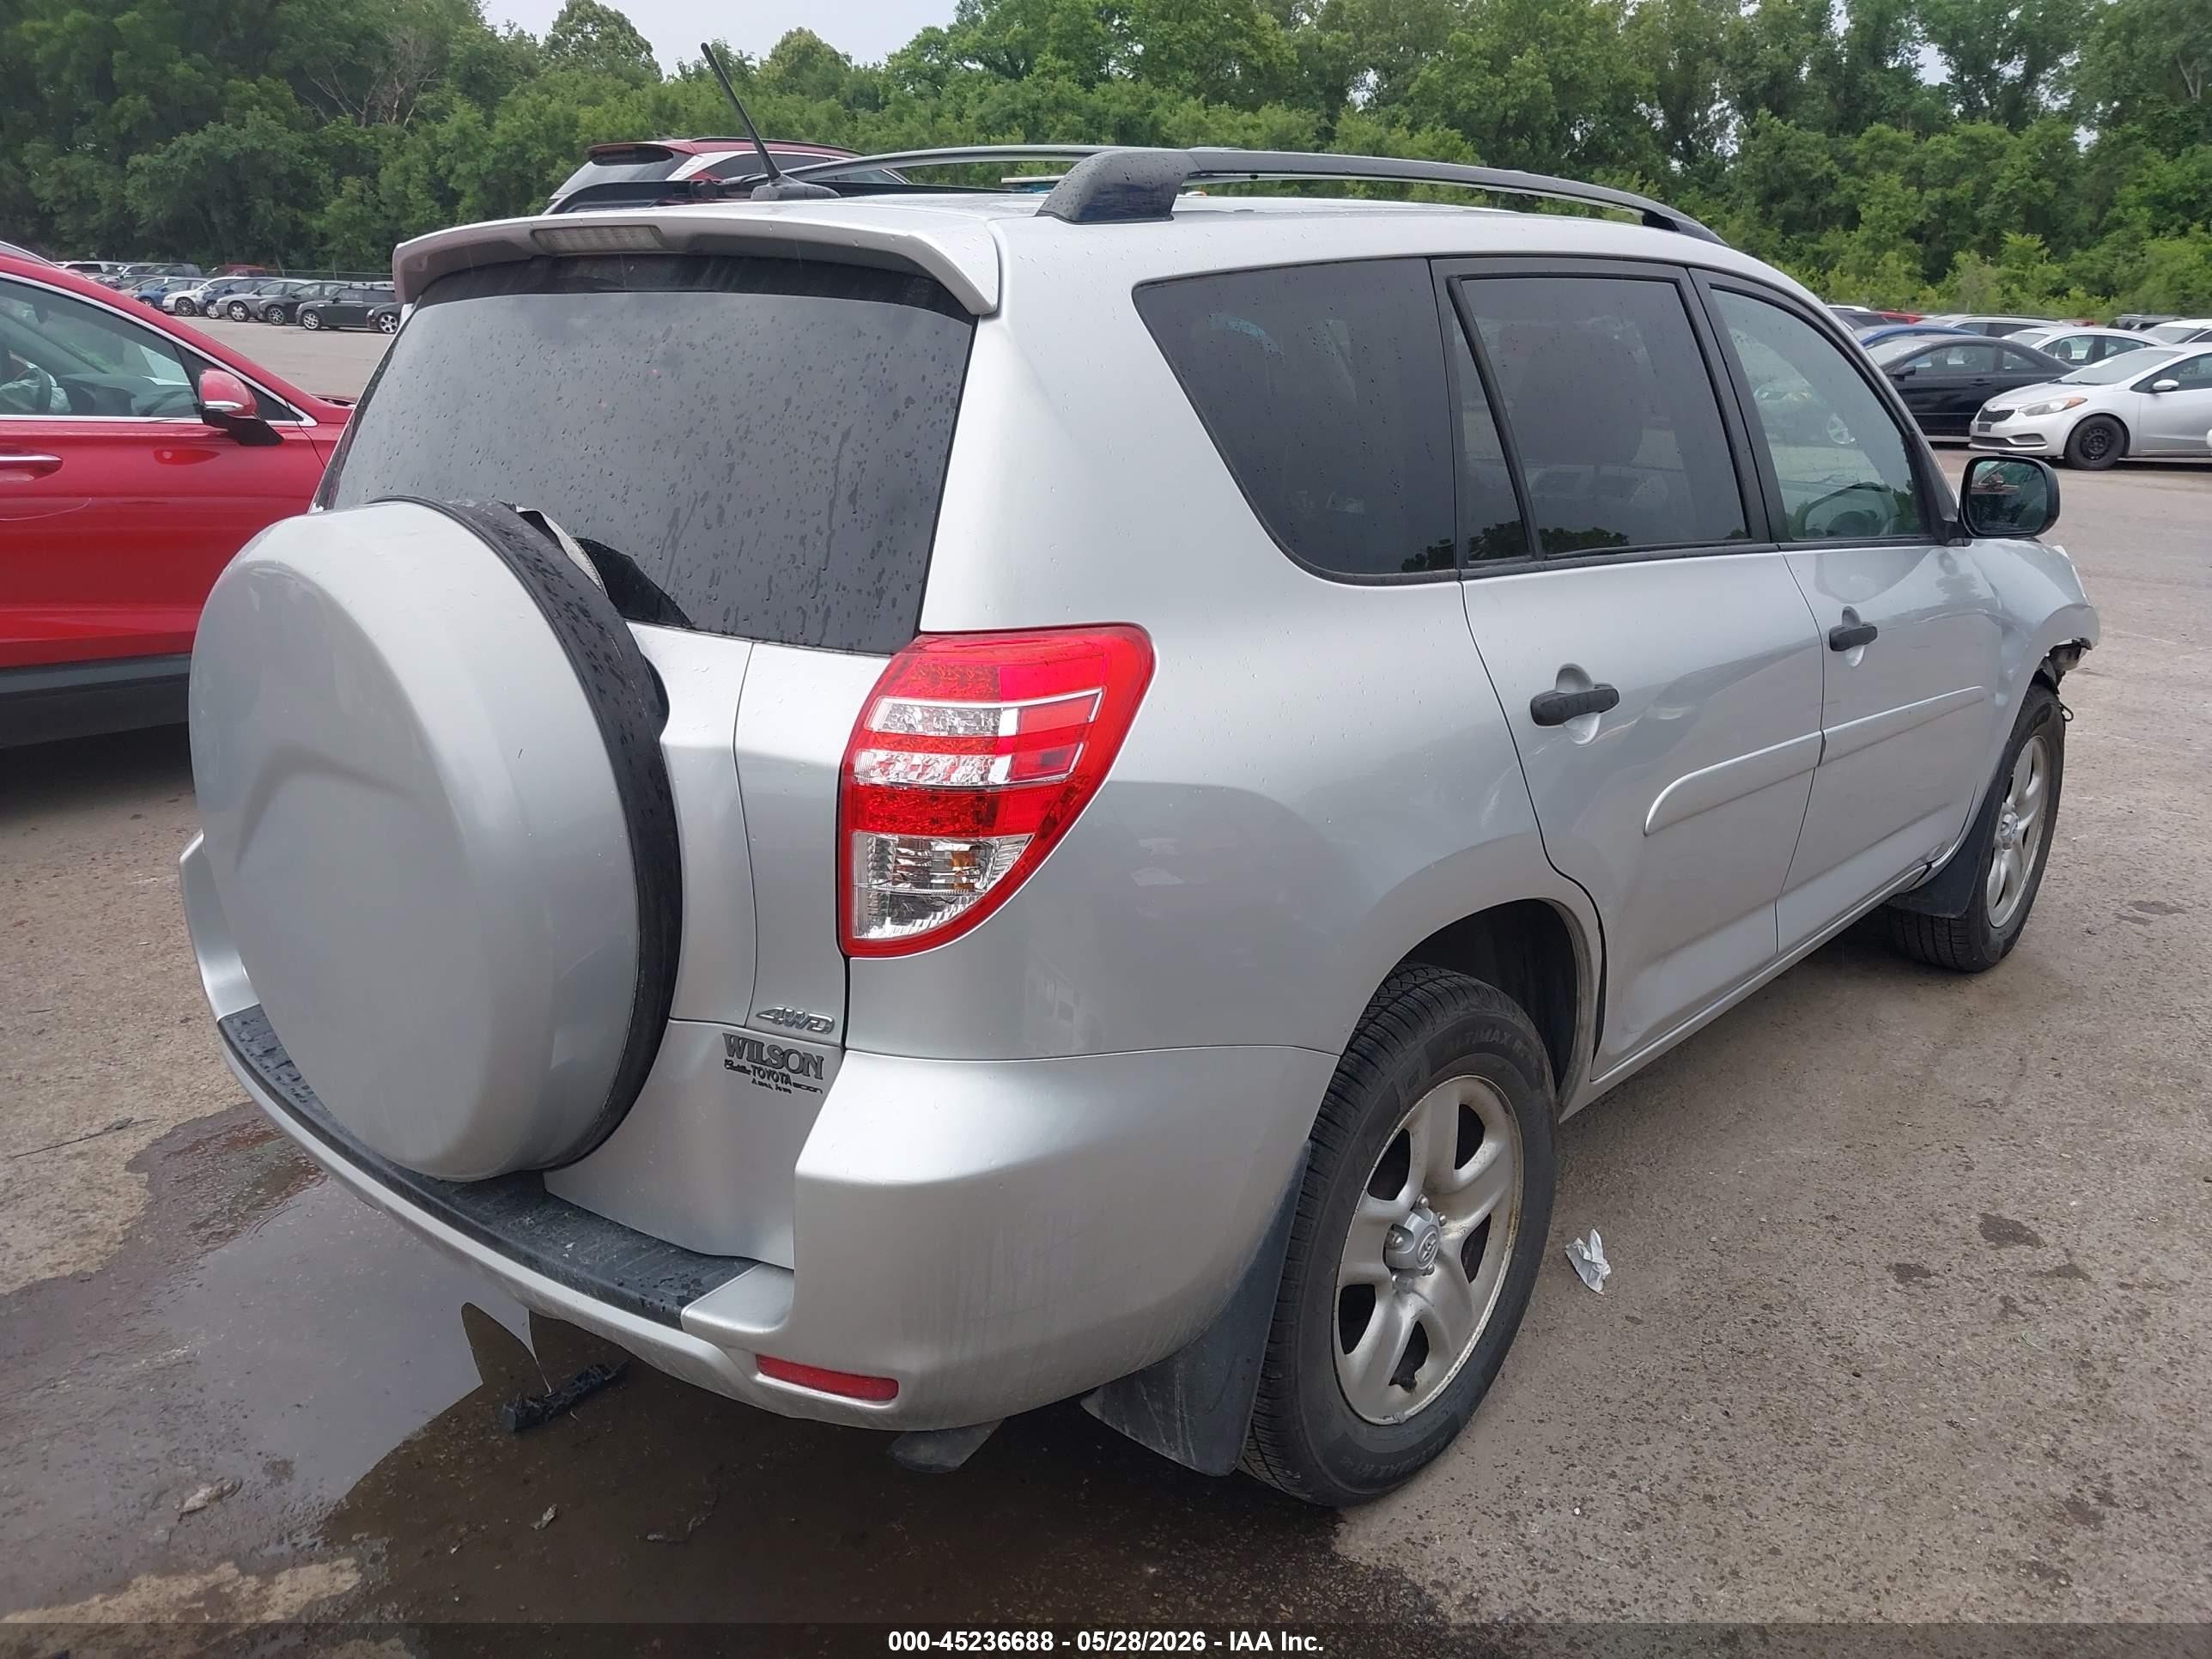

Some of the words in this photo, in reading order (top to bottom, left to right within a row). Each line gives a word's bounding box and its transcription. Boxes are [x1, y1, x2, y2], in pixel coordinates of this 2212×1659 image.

[757, 1006, 835, 1034] 4WD
[722, 1033, 824, 1080] WILSON
[751, 1065, 793, 1085] TOYOTA
